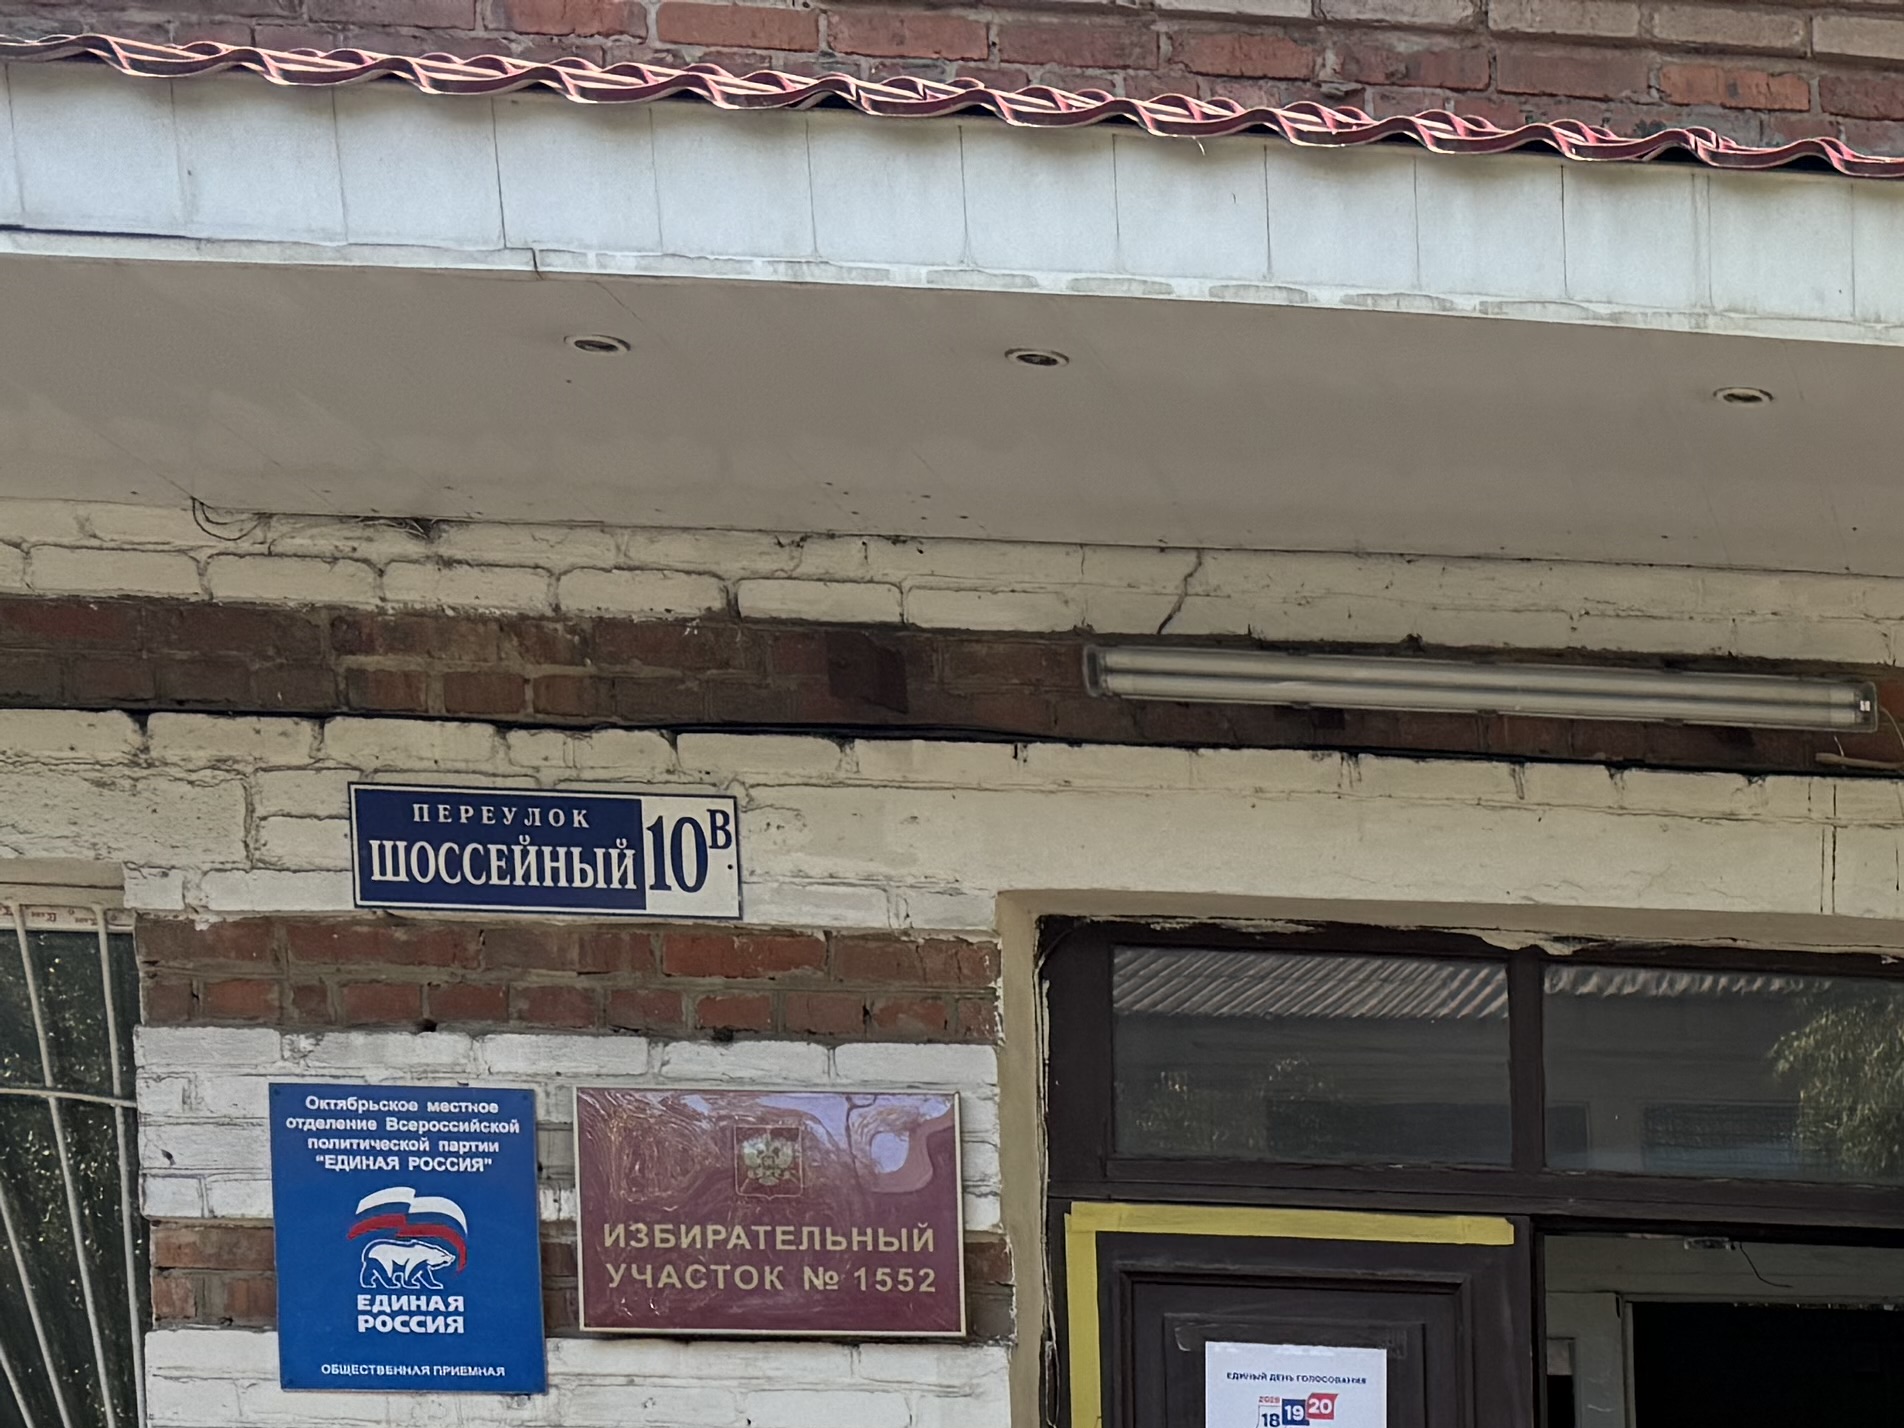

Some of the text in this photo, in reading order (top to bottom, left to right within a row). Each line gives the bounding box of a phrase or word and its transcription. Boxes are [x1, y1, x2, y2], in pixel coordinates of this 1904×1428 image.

[412, 803, 590, 828] ПЕРЕУЛОК
[369, 835, 638, 891] ШОССЕЙНЫЙ
[304, 1096, 499, 1114] Октябрьское местное
[285, 1117, 521, 1134] отделение Всероссийской
[307, 1137, 500, 1155] политической партии
[603, 1221, 936, 1253] ИЗБИРАТЕЛЬНЫЙ
[605, 1262, 937, 1293] УЧАСТОК № 1552
[356, 1294, 465, 1314] ЕДИНАЯ
[357, 1314, 465, 1334] РОССИЯ
[320, 1363, 506, 1378] ОБЩЕСТВЕННАЯ ПРИЕМНАЯ
[1226, 1371, 1367, 1385] ЕДИНЫЙ ДЕНЬ ГОЛОСОВАНИЯ
[1261, 1398, 1333, 1428] 18 19 20
